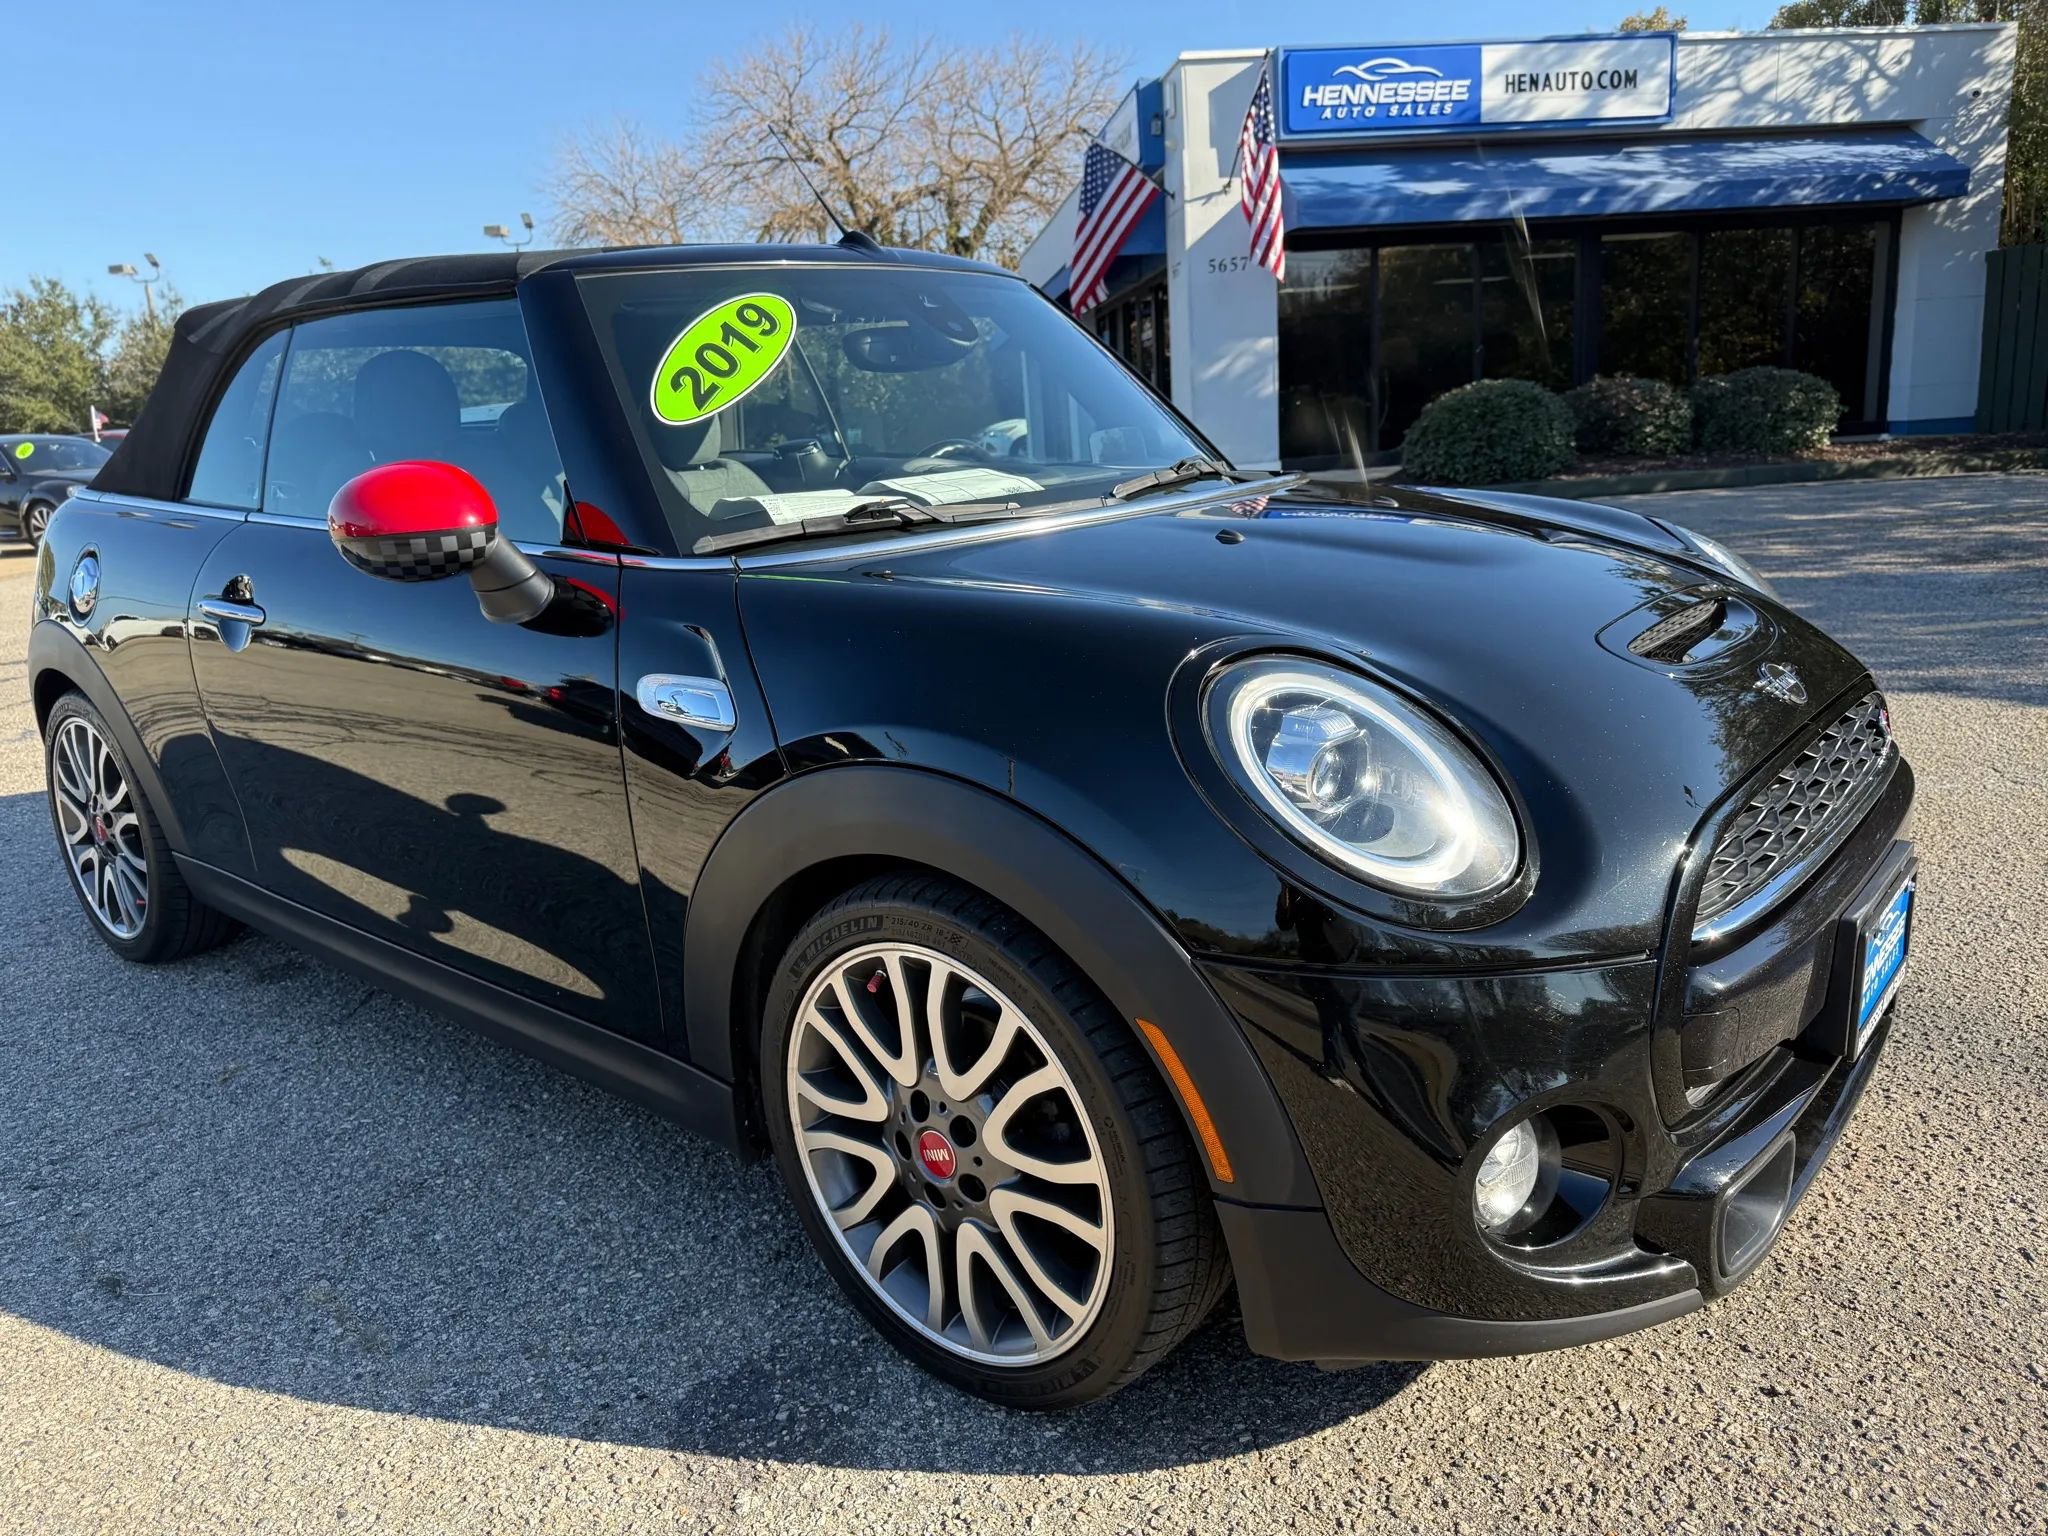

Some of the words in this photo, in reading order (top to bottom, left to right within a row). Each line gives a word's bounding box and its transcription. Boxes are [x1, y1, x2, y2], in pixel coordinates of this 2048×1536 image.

[1302, 79, 1472, 107] HENNESSEE
[1321, 106, 1376, 120] AUTO
[1388, 103, 1453, 117] SALES
[1208, 256, 1248, 274] 5657
[670, 303, 780, 412] 2019
[806, 914, 878, 960] MICHELIN
[923, 1148, 950, 1162] MINI
